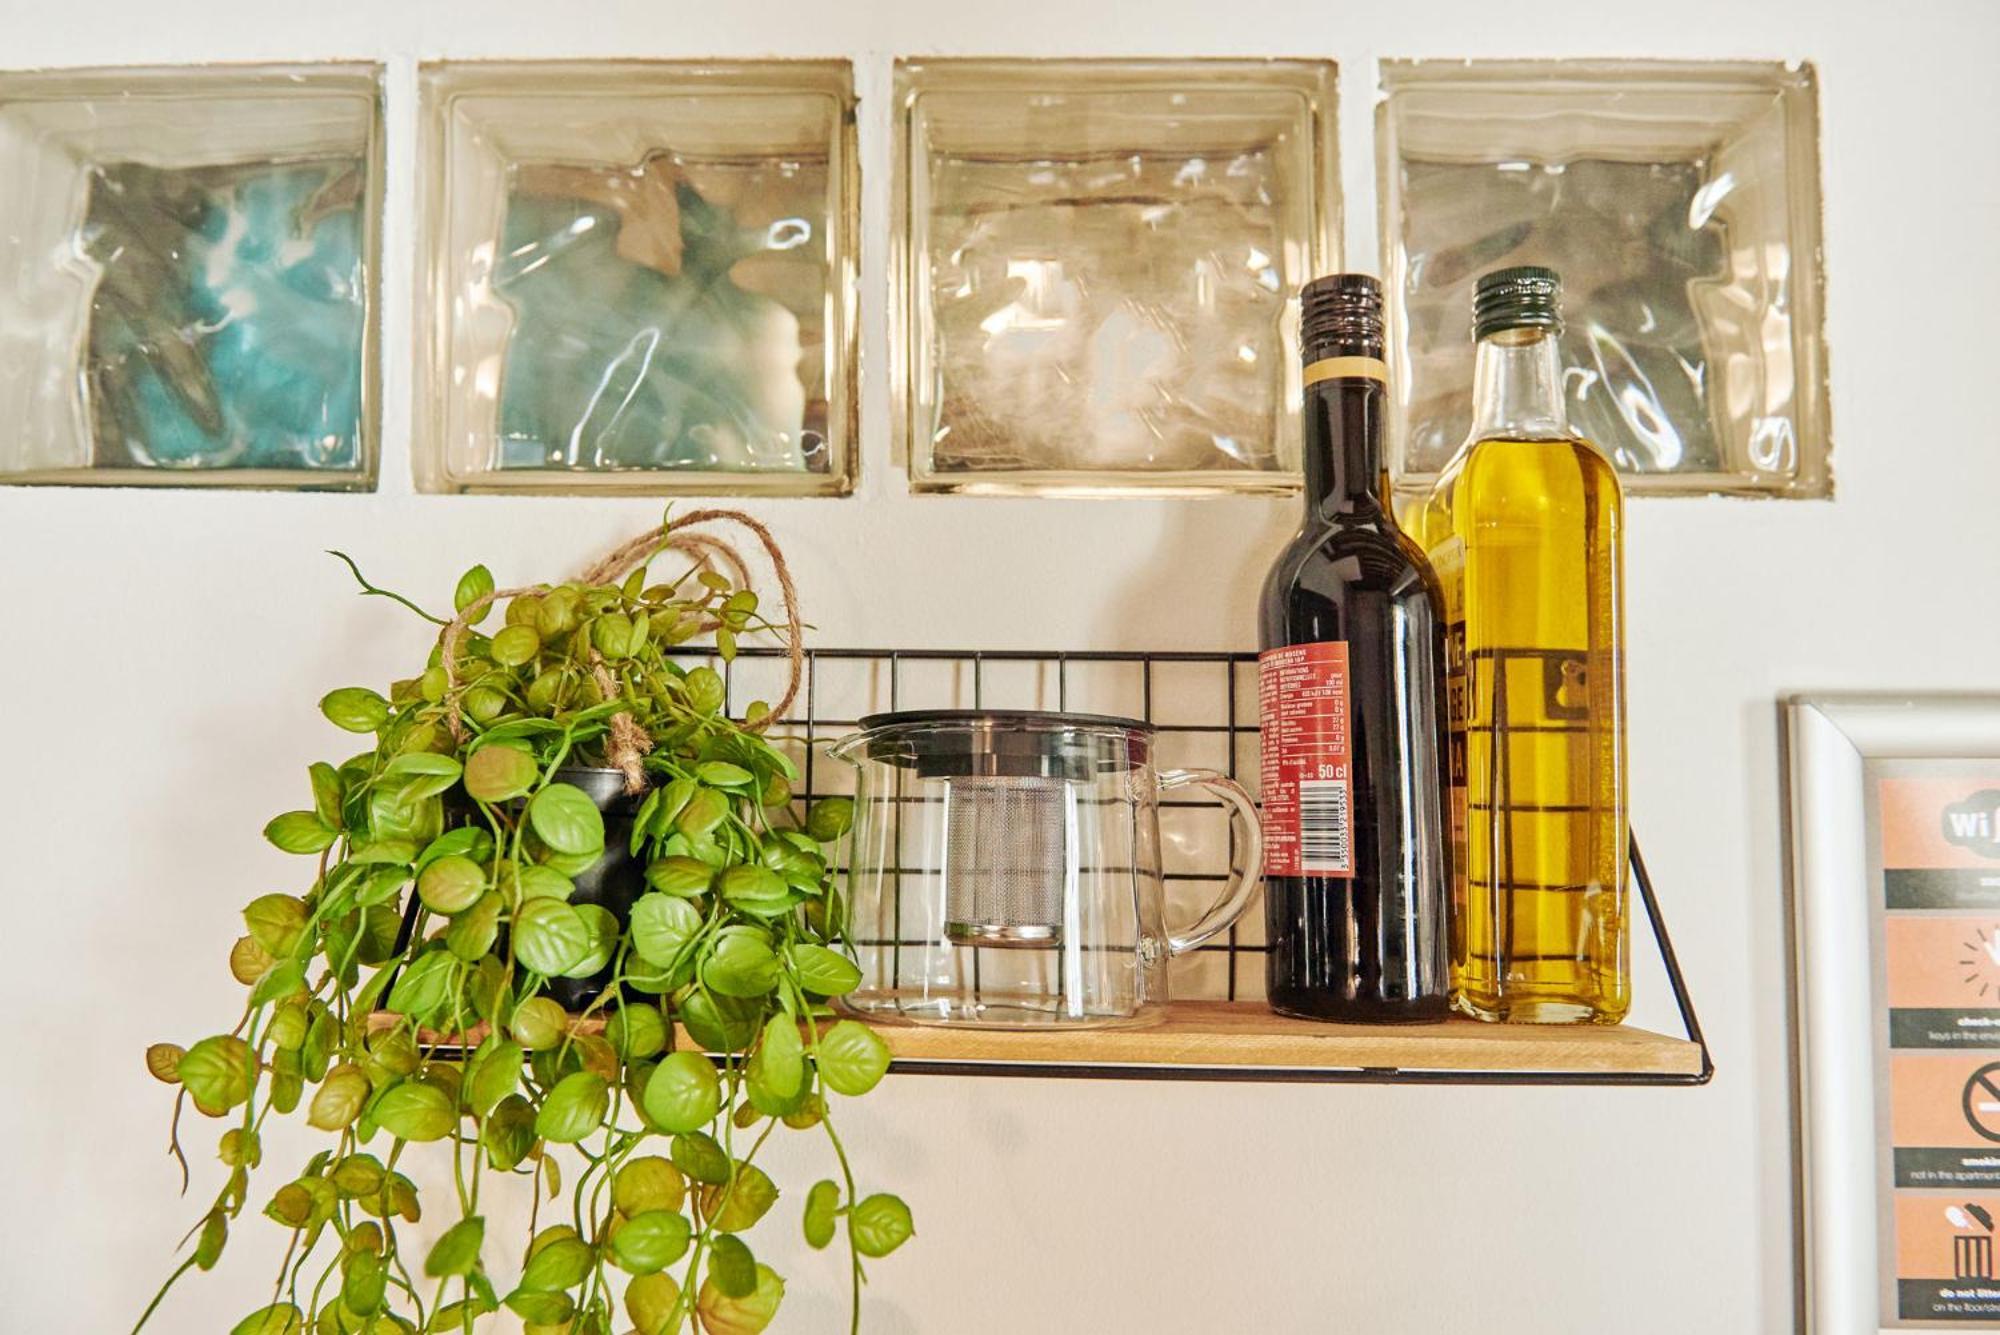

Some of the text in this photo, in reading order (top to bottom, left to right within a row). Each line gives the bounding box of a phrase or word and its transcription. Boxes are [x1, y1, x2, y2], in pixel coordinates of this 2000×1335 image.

[1318, 765, 1334, 778] 50
[1336, 764, 1347, 778] cl
[1939, 1288, 1955, 1299] do
[1955, 1288, 1976, 1299] not
[1932, 1304, 1946, 1312] on
[1947, 1303, 1962, 1312] the
